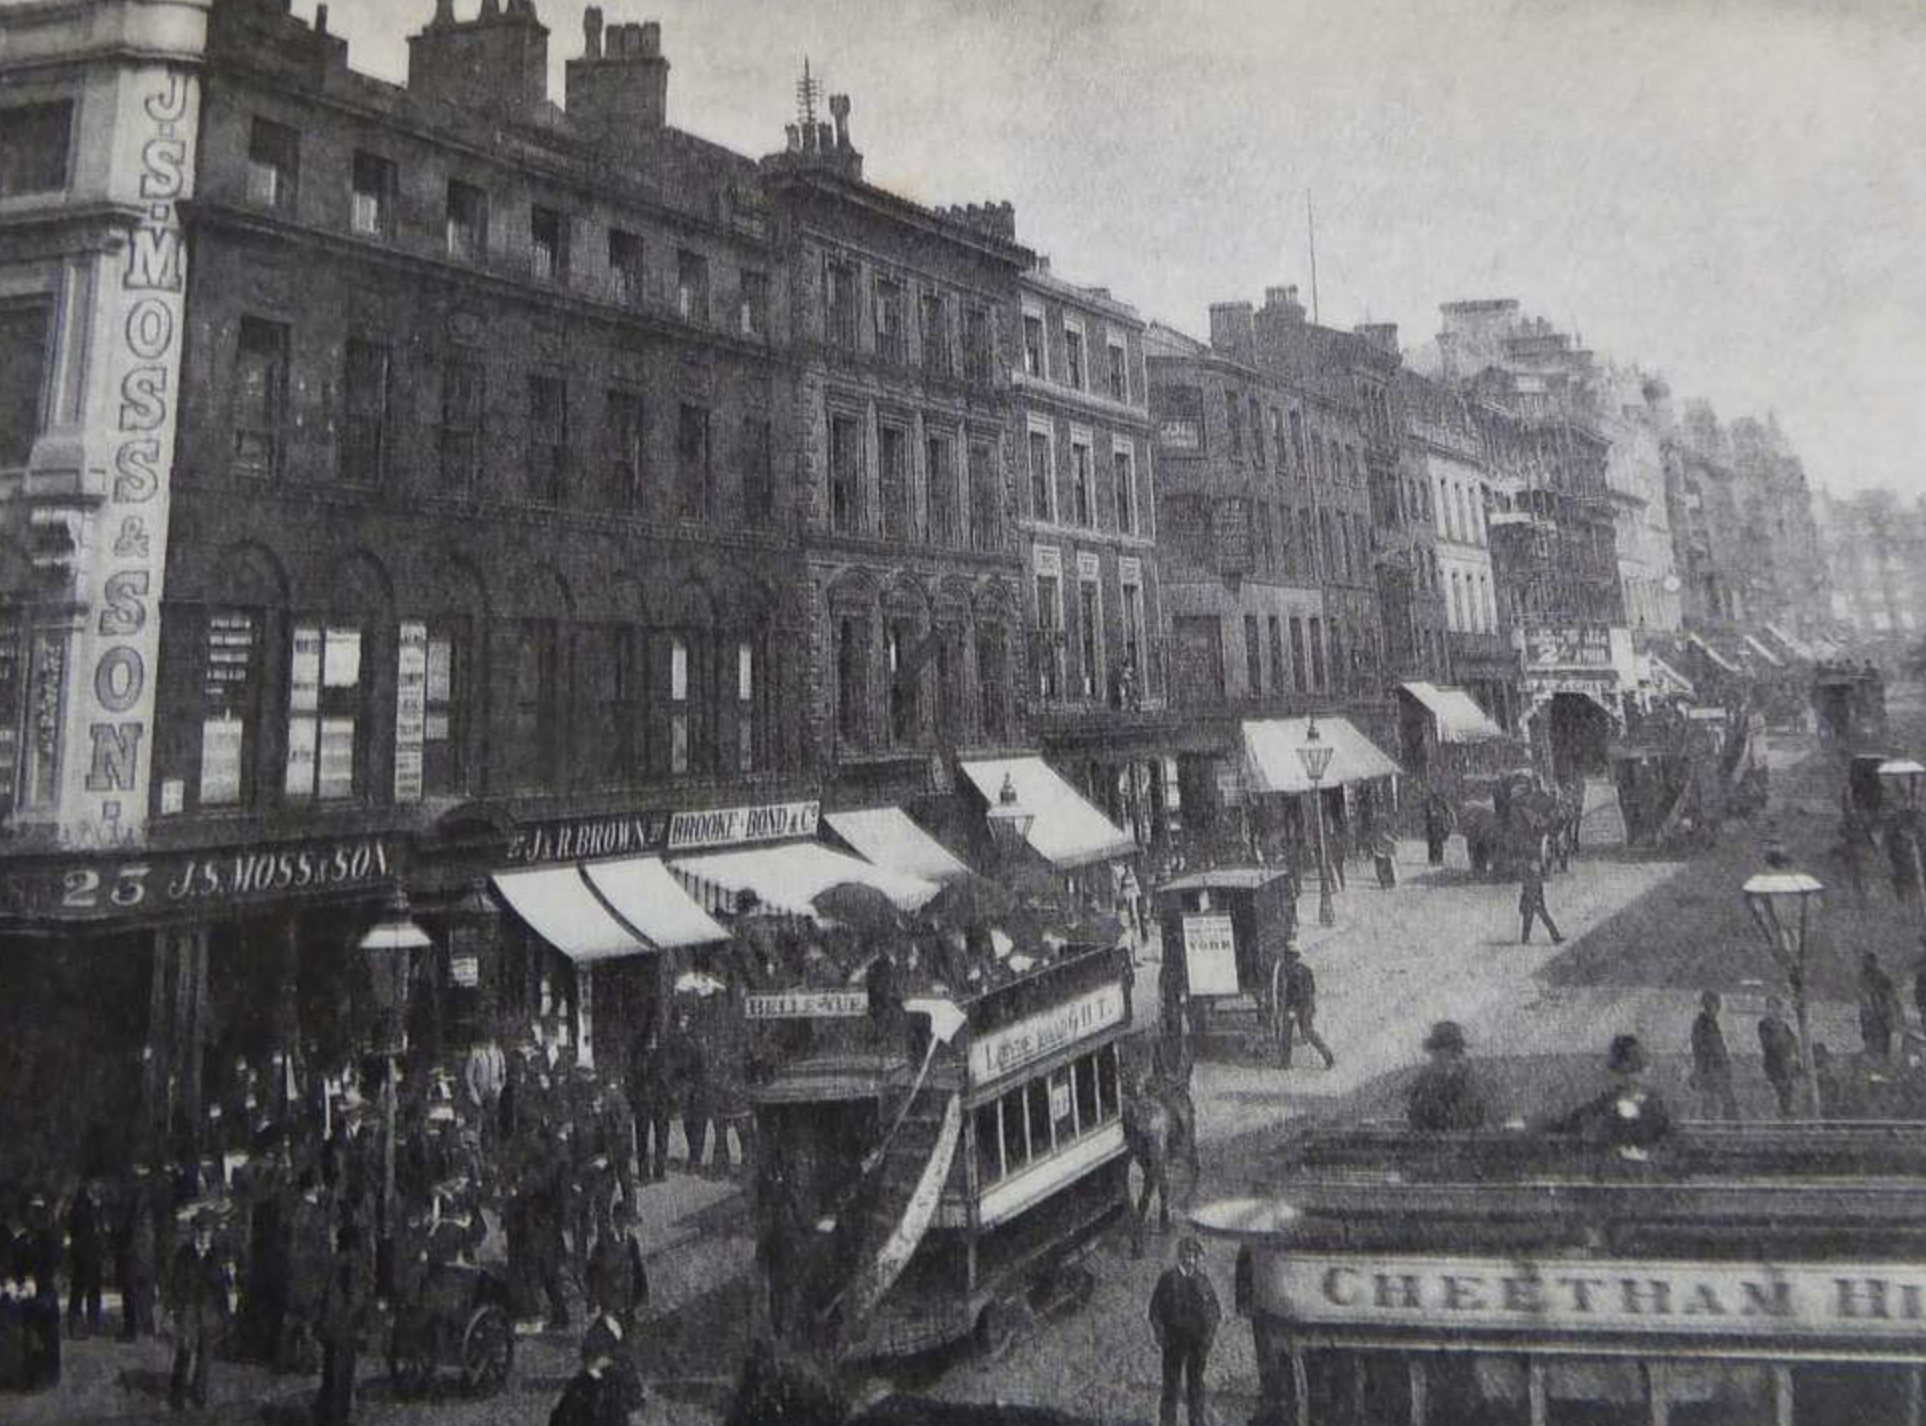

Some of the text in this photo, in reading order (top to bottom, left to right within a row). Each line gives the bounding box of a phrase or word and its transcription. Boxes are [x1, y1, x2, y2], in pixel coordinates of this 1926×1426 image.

[115, 227, 183, 503] MOSS
[117, 517, 150, 558] &
[575, 819, 648, 856] BROWN
[671, 811, 742, 846] BROOKE
[745, 806, 788, 840] BOND
[234, 851, 312, 891] MOSS
